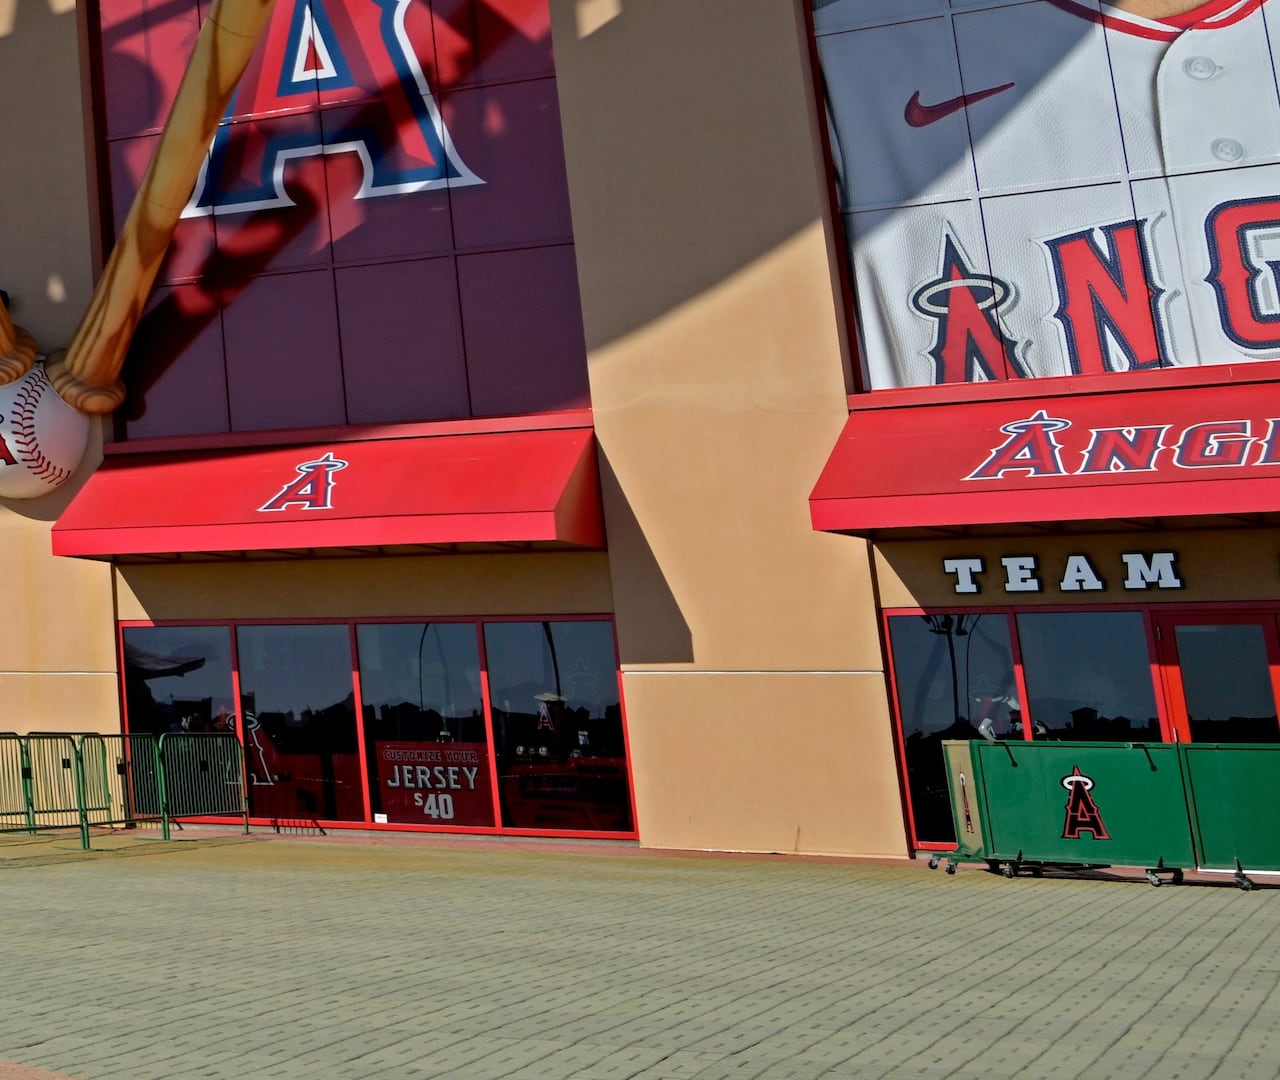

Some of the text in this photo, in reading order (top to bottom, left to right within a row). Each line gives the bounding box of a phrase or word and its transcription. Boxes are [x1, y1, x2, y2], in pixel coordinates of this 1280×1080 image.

[943, 552, 1184, 594] TEAM
[384, 749, 479, 763] CUSTOMIZE YOUR
[386, 765, 479, 790] JERSEY
